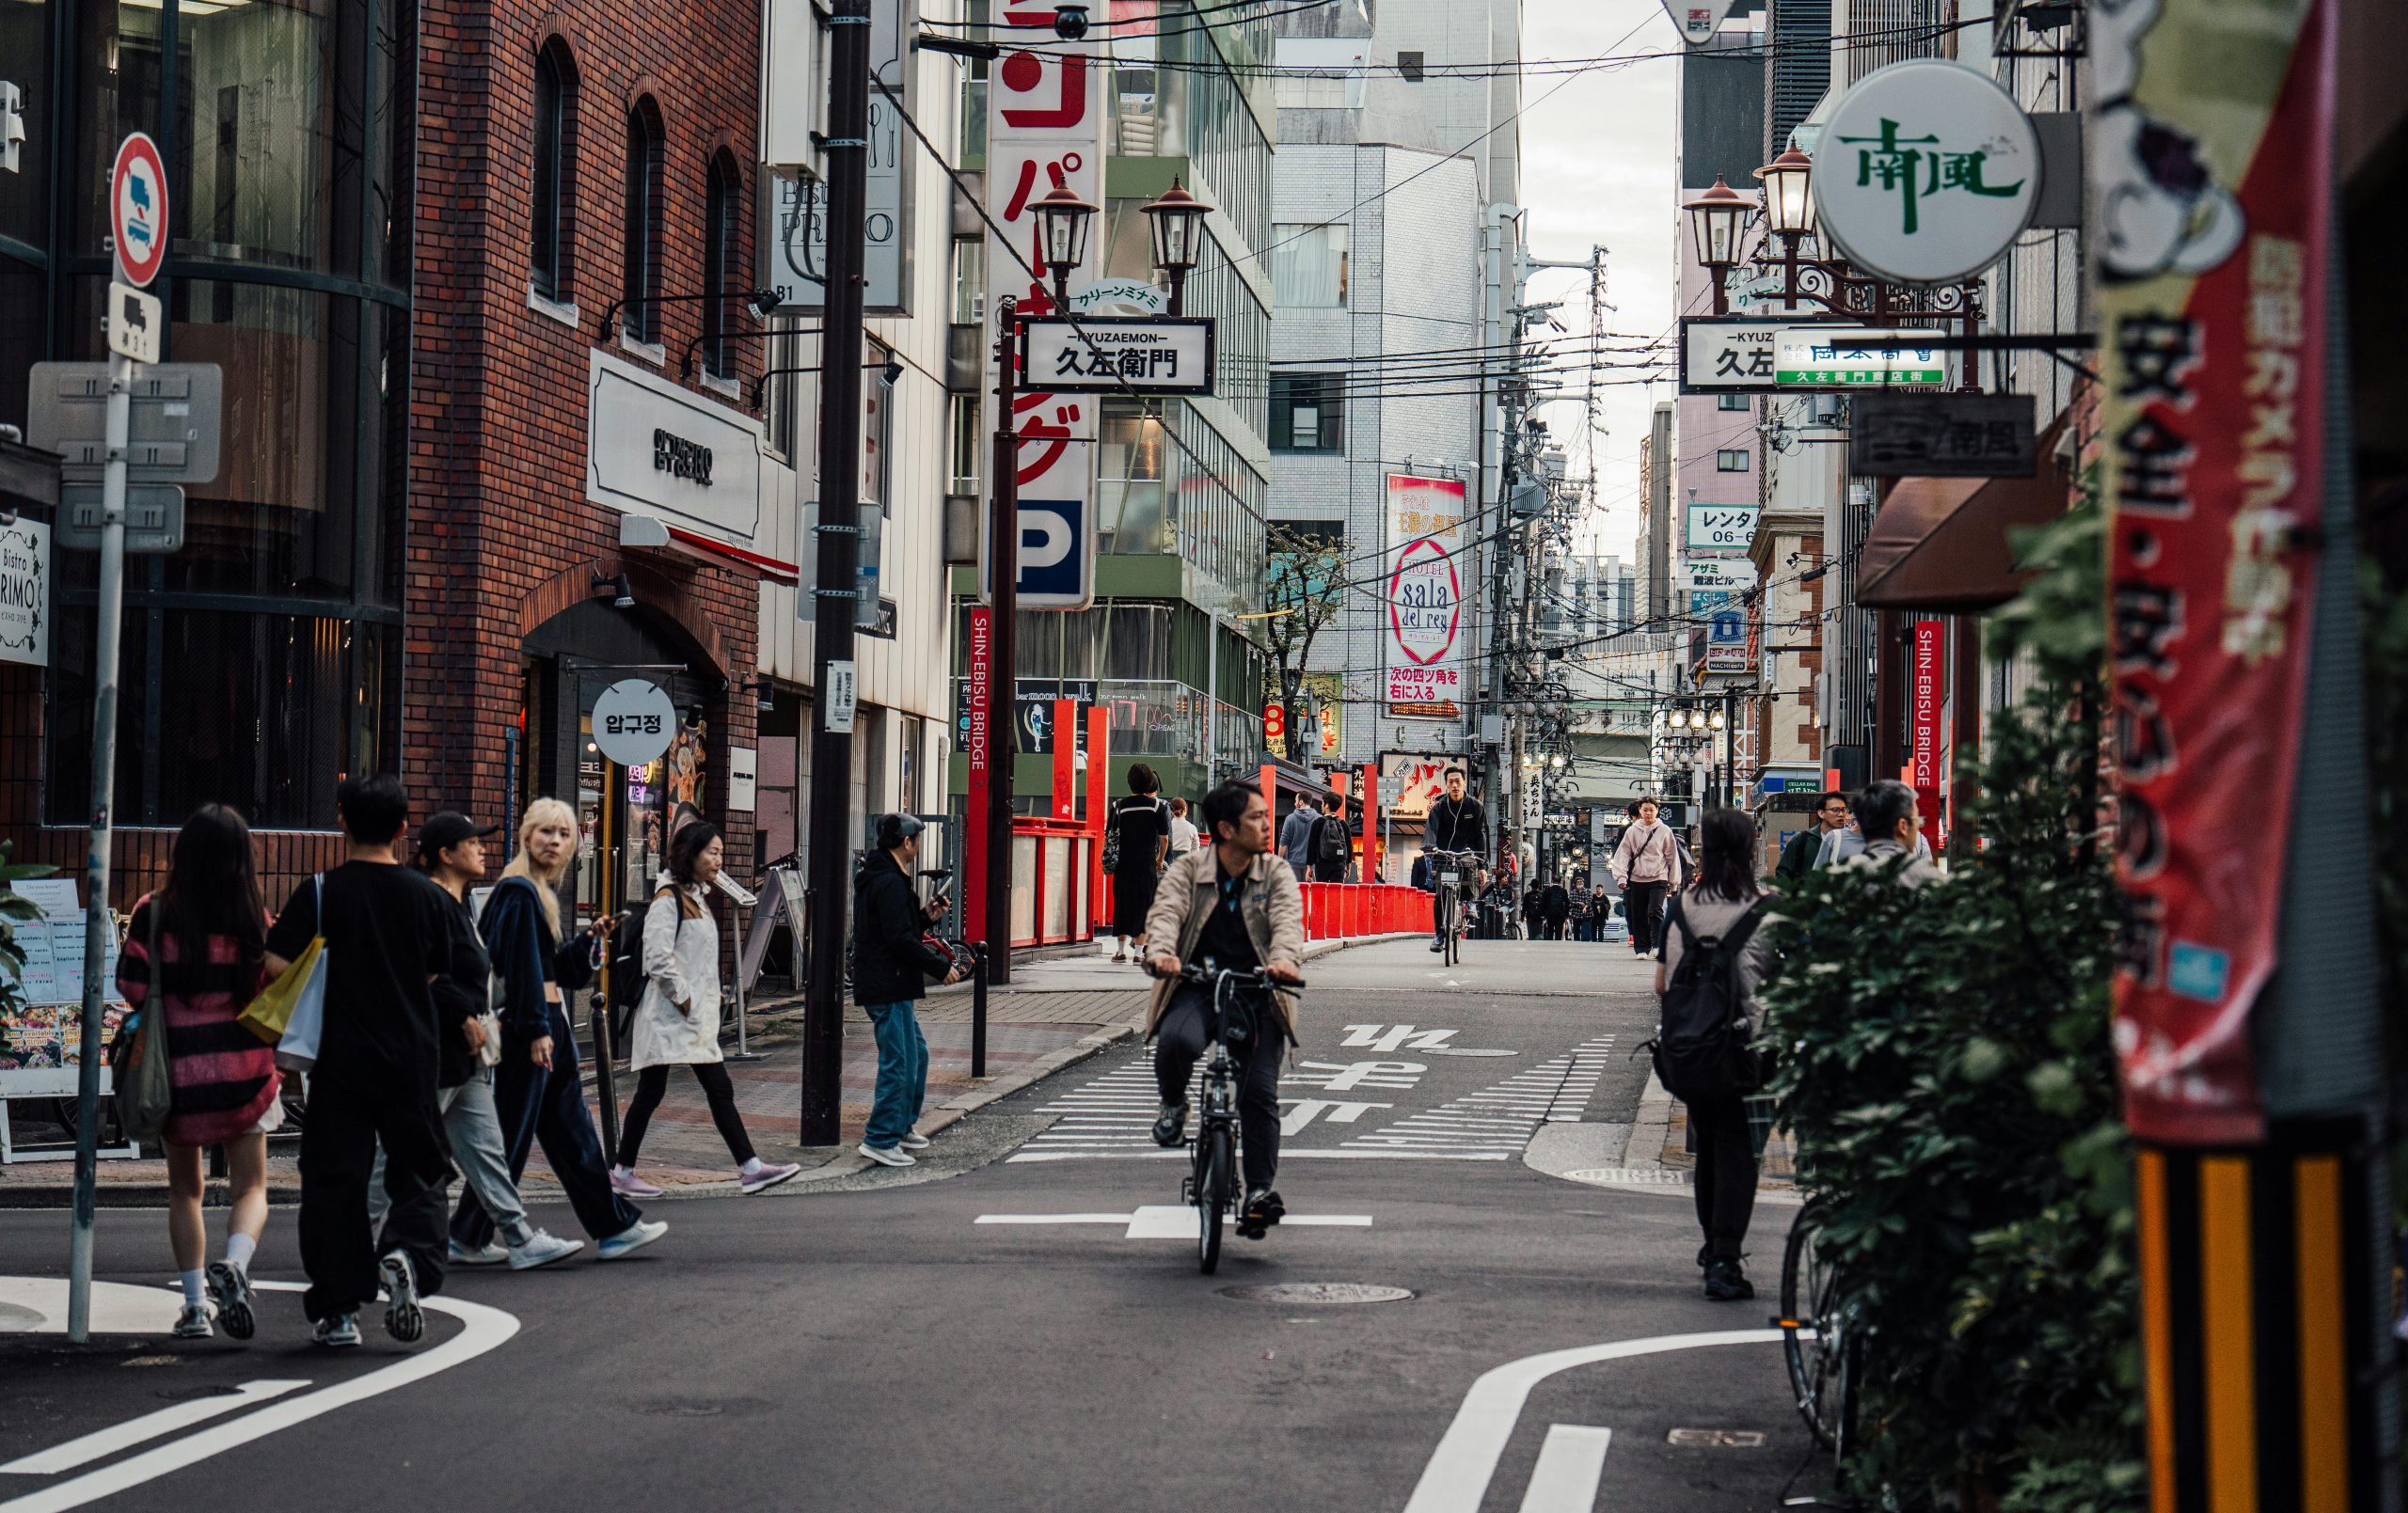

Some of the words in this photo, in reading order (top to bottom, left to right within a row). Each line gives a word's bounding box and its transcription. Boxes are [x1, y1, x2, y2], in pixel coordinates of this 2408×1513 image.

[1836, 118, 2025, 234] 南風
[781, 213, 894, 243] PRO
[777, 285, 793, 300] B1
[1079, 285, 1159, 308] クリーンミナミ
[1055, 347, 1178, 378] 久左衛門
[1797, 370, 1923, 382] 久左衛門商店街
[1401, 495, 1430, 510] それは
[4, 548, 27, 571] Bistro
[1409, 561, 1444, 575] HOTEL
[1689, 564, 1719, 574] アザミ
[1694, 575, 1735, 586] 難波ビル
[1403, 578, 1448, 609] sala
[1402, 607, 1420, 627] del
[1426, 614, 1448, 633] rey
[974, 618, 987, 707] SHIN-EBISU
[1390, 668, 1458, 685] 次の四ツ角を
[1918, 630, 1932, 721] SHIN-EBISU
[1029, 690, 1057, 701] moon
[1064, 683, 1093, 701] walk
[1098, 691, 1109, 700] bar
[1389, 686, 1435, 700] 右に入る
[606, 715, 661, 734] 압구정
[972, 712, 985, 770] BRIDGE
[1917, 727, 1930, 786] BRIDGE
[1529, 774, 1540, 817] 英ちゃん
